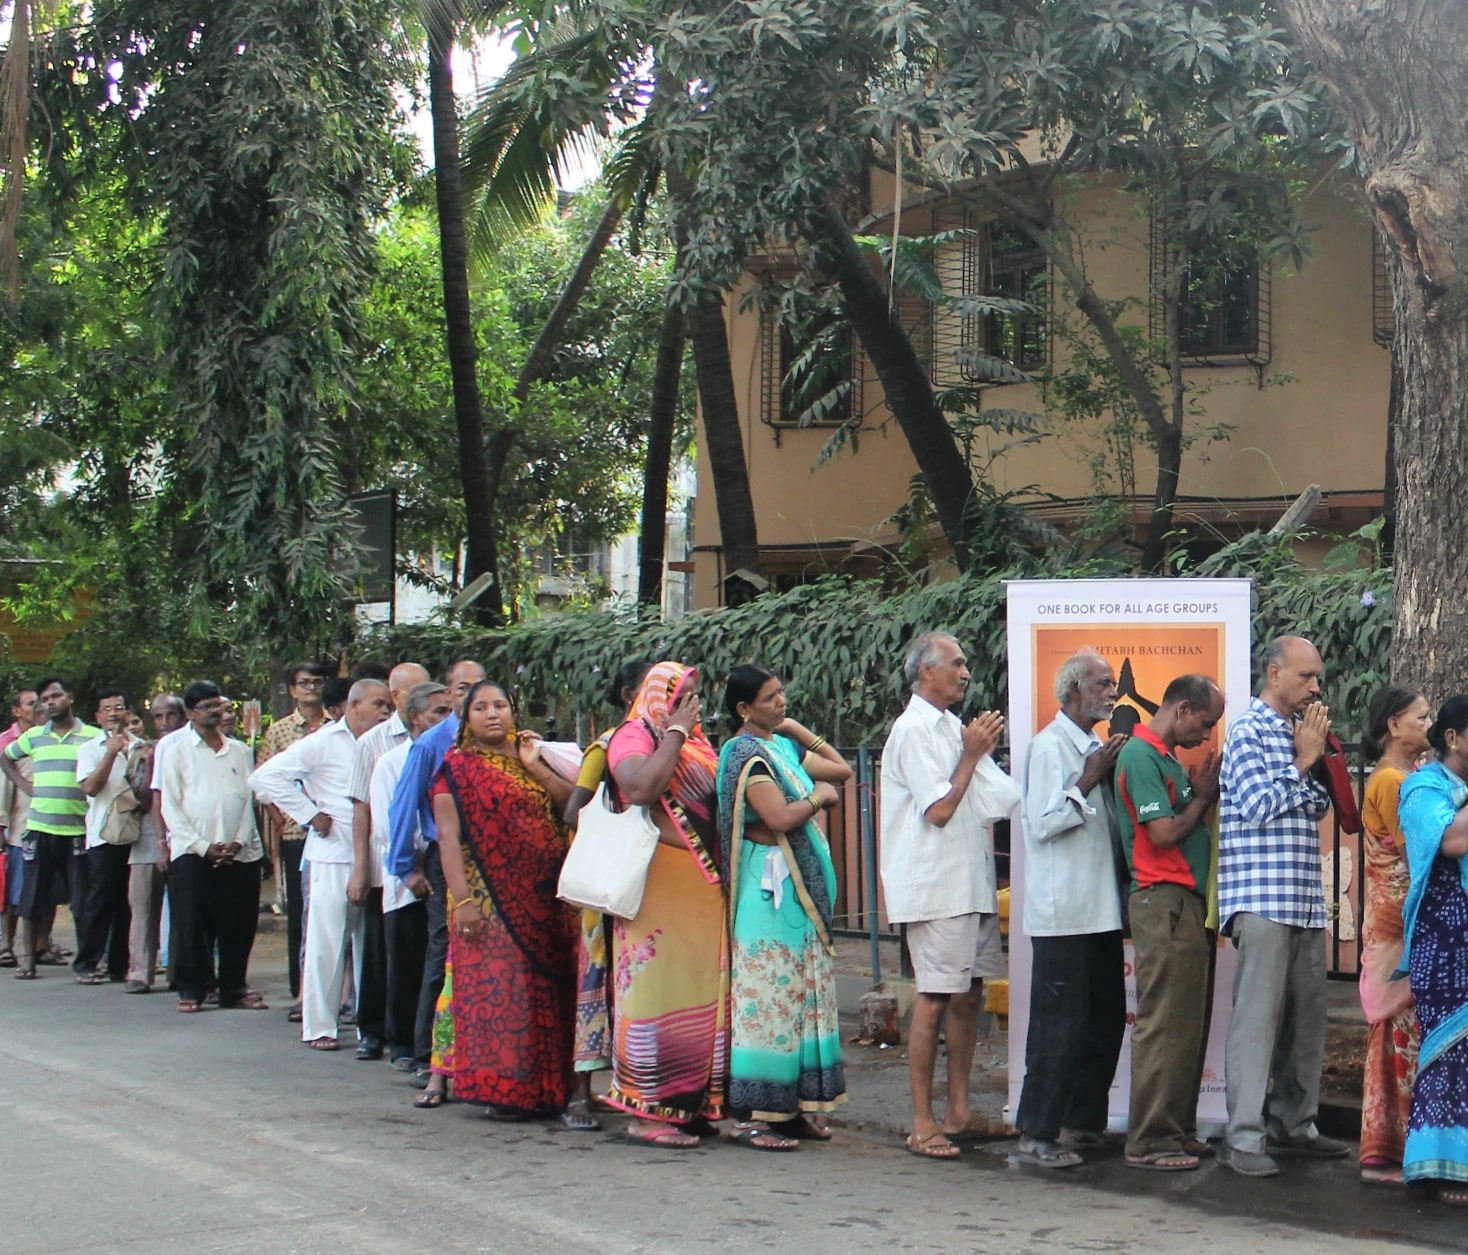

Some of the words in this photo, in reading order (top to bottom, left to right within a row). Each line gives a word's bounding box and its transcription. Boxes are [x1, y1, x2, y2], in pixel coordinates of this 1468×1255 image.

[1038, 604, 1061, 614] ONE
[1064, 604, 1096, 614] BOOK
[1100, 603, 1121, 614] FOR
[1124, 603, 1143, 614] ALL
[1146, 603, 1169, 613] AGE
[1173, 603, 1218, 613] GROUPS
[1096, 645, 1135, 655] ITABH
[1139, 646, 1203, 655] BACHCHAN
